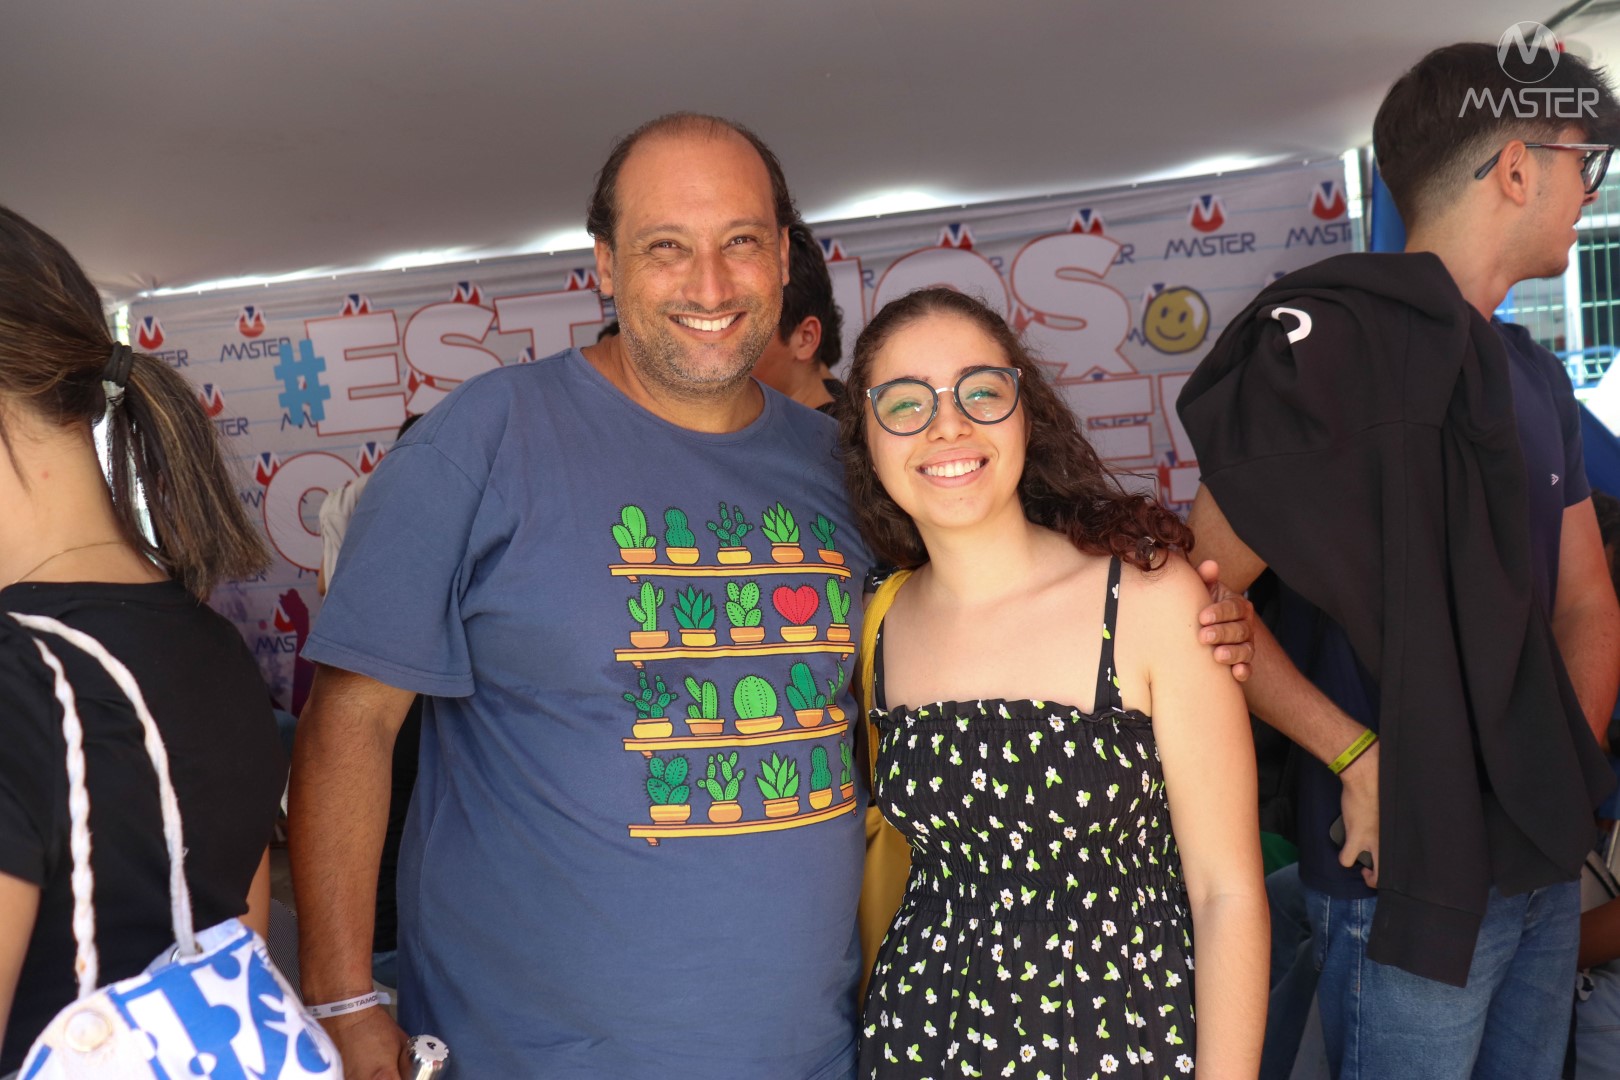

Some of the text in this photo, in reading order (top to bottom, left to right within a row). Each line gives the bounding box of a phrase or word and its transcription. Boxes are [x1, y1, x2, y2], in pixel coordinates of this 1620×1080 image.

[1164, 232, 1256, 260] MASTER
[1285, 222, 1352, 249] MAST
[256, 634, 297, 653] MAS
